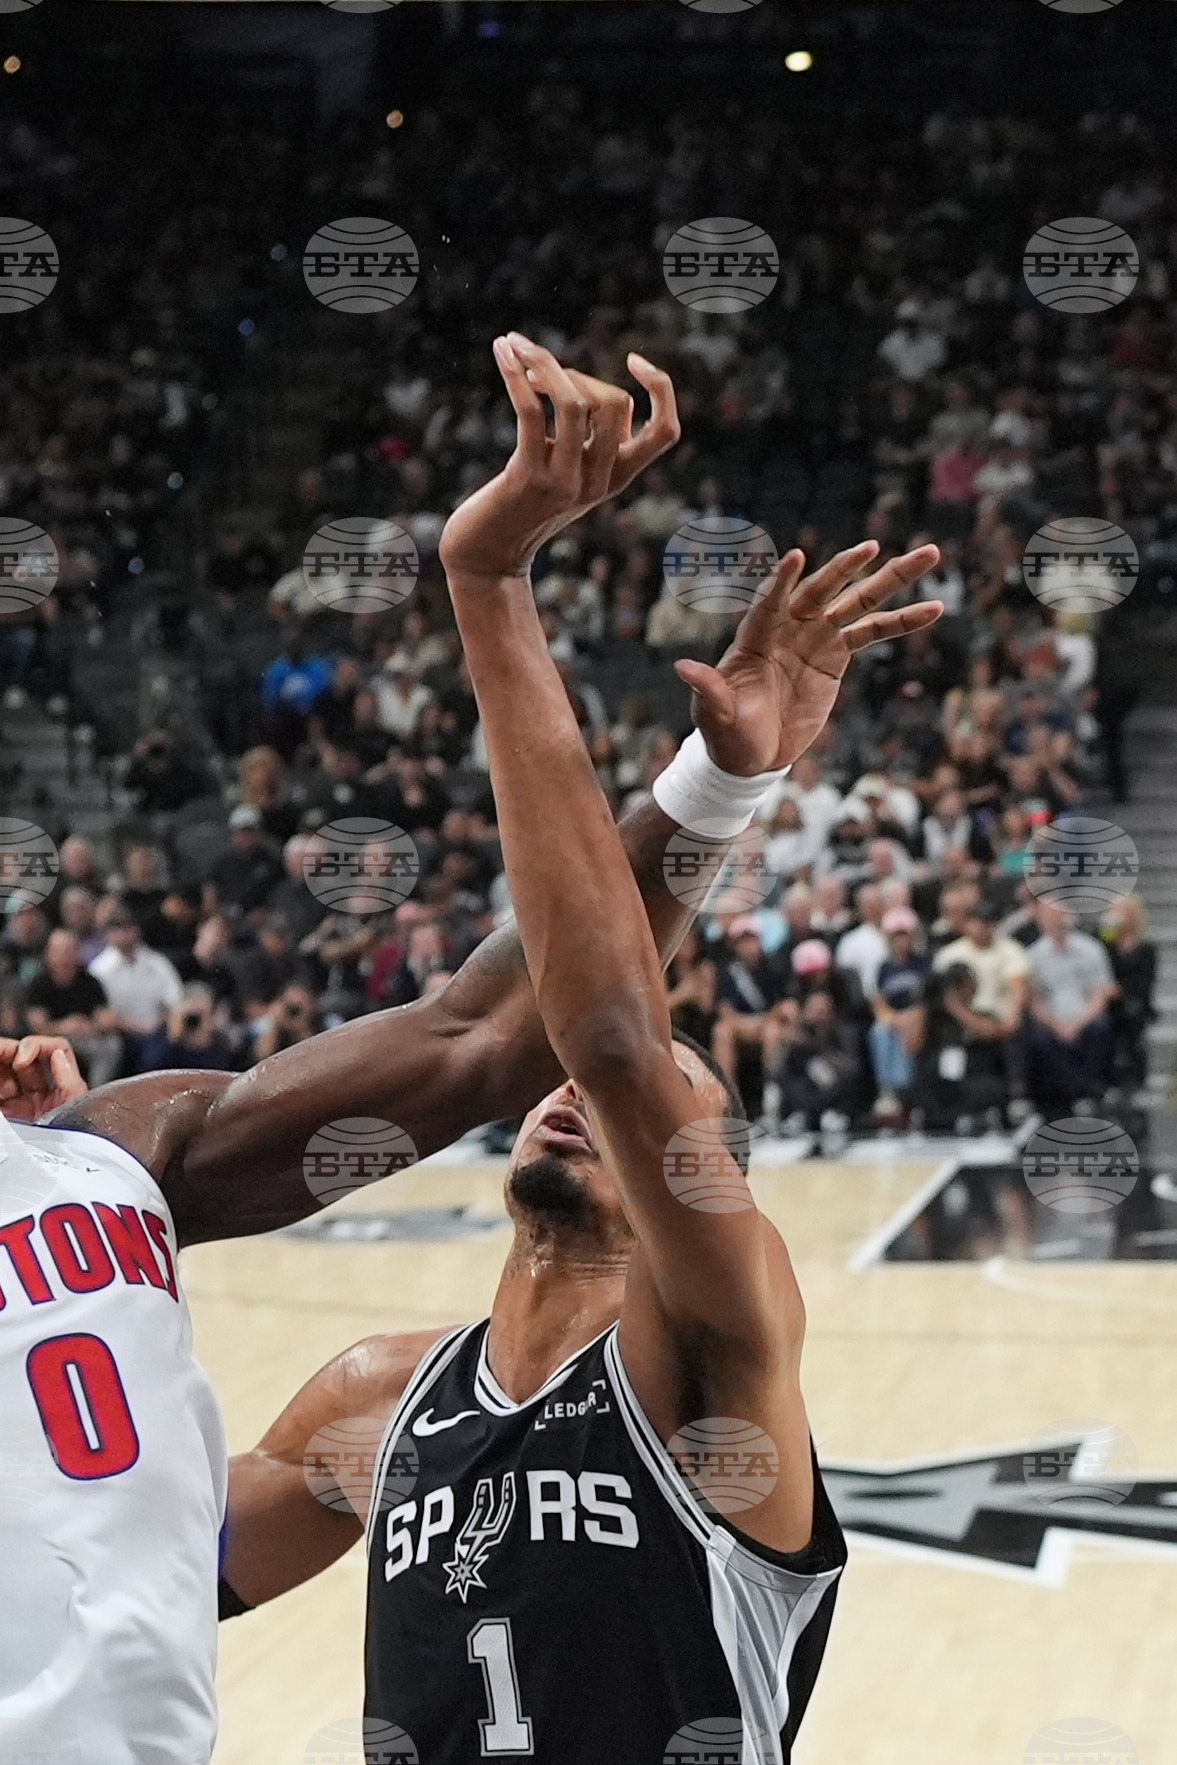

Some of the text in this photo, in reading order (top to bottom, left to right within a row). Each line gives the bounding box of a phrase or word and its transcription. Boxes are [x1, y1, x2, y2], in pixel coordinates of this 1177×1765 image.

[26, 1332, 140, 1481] 0
[543, 1391, 597, 1420] LEDGR
[384, 1469, 640, 1604] SPURS
[466, 1617, 535, 1757] 1
